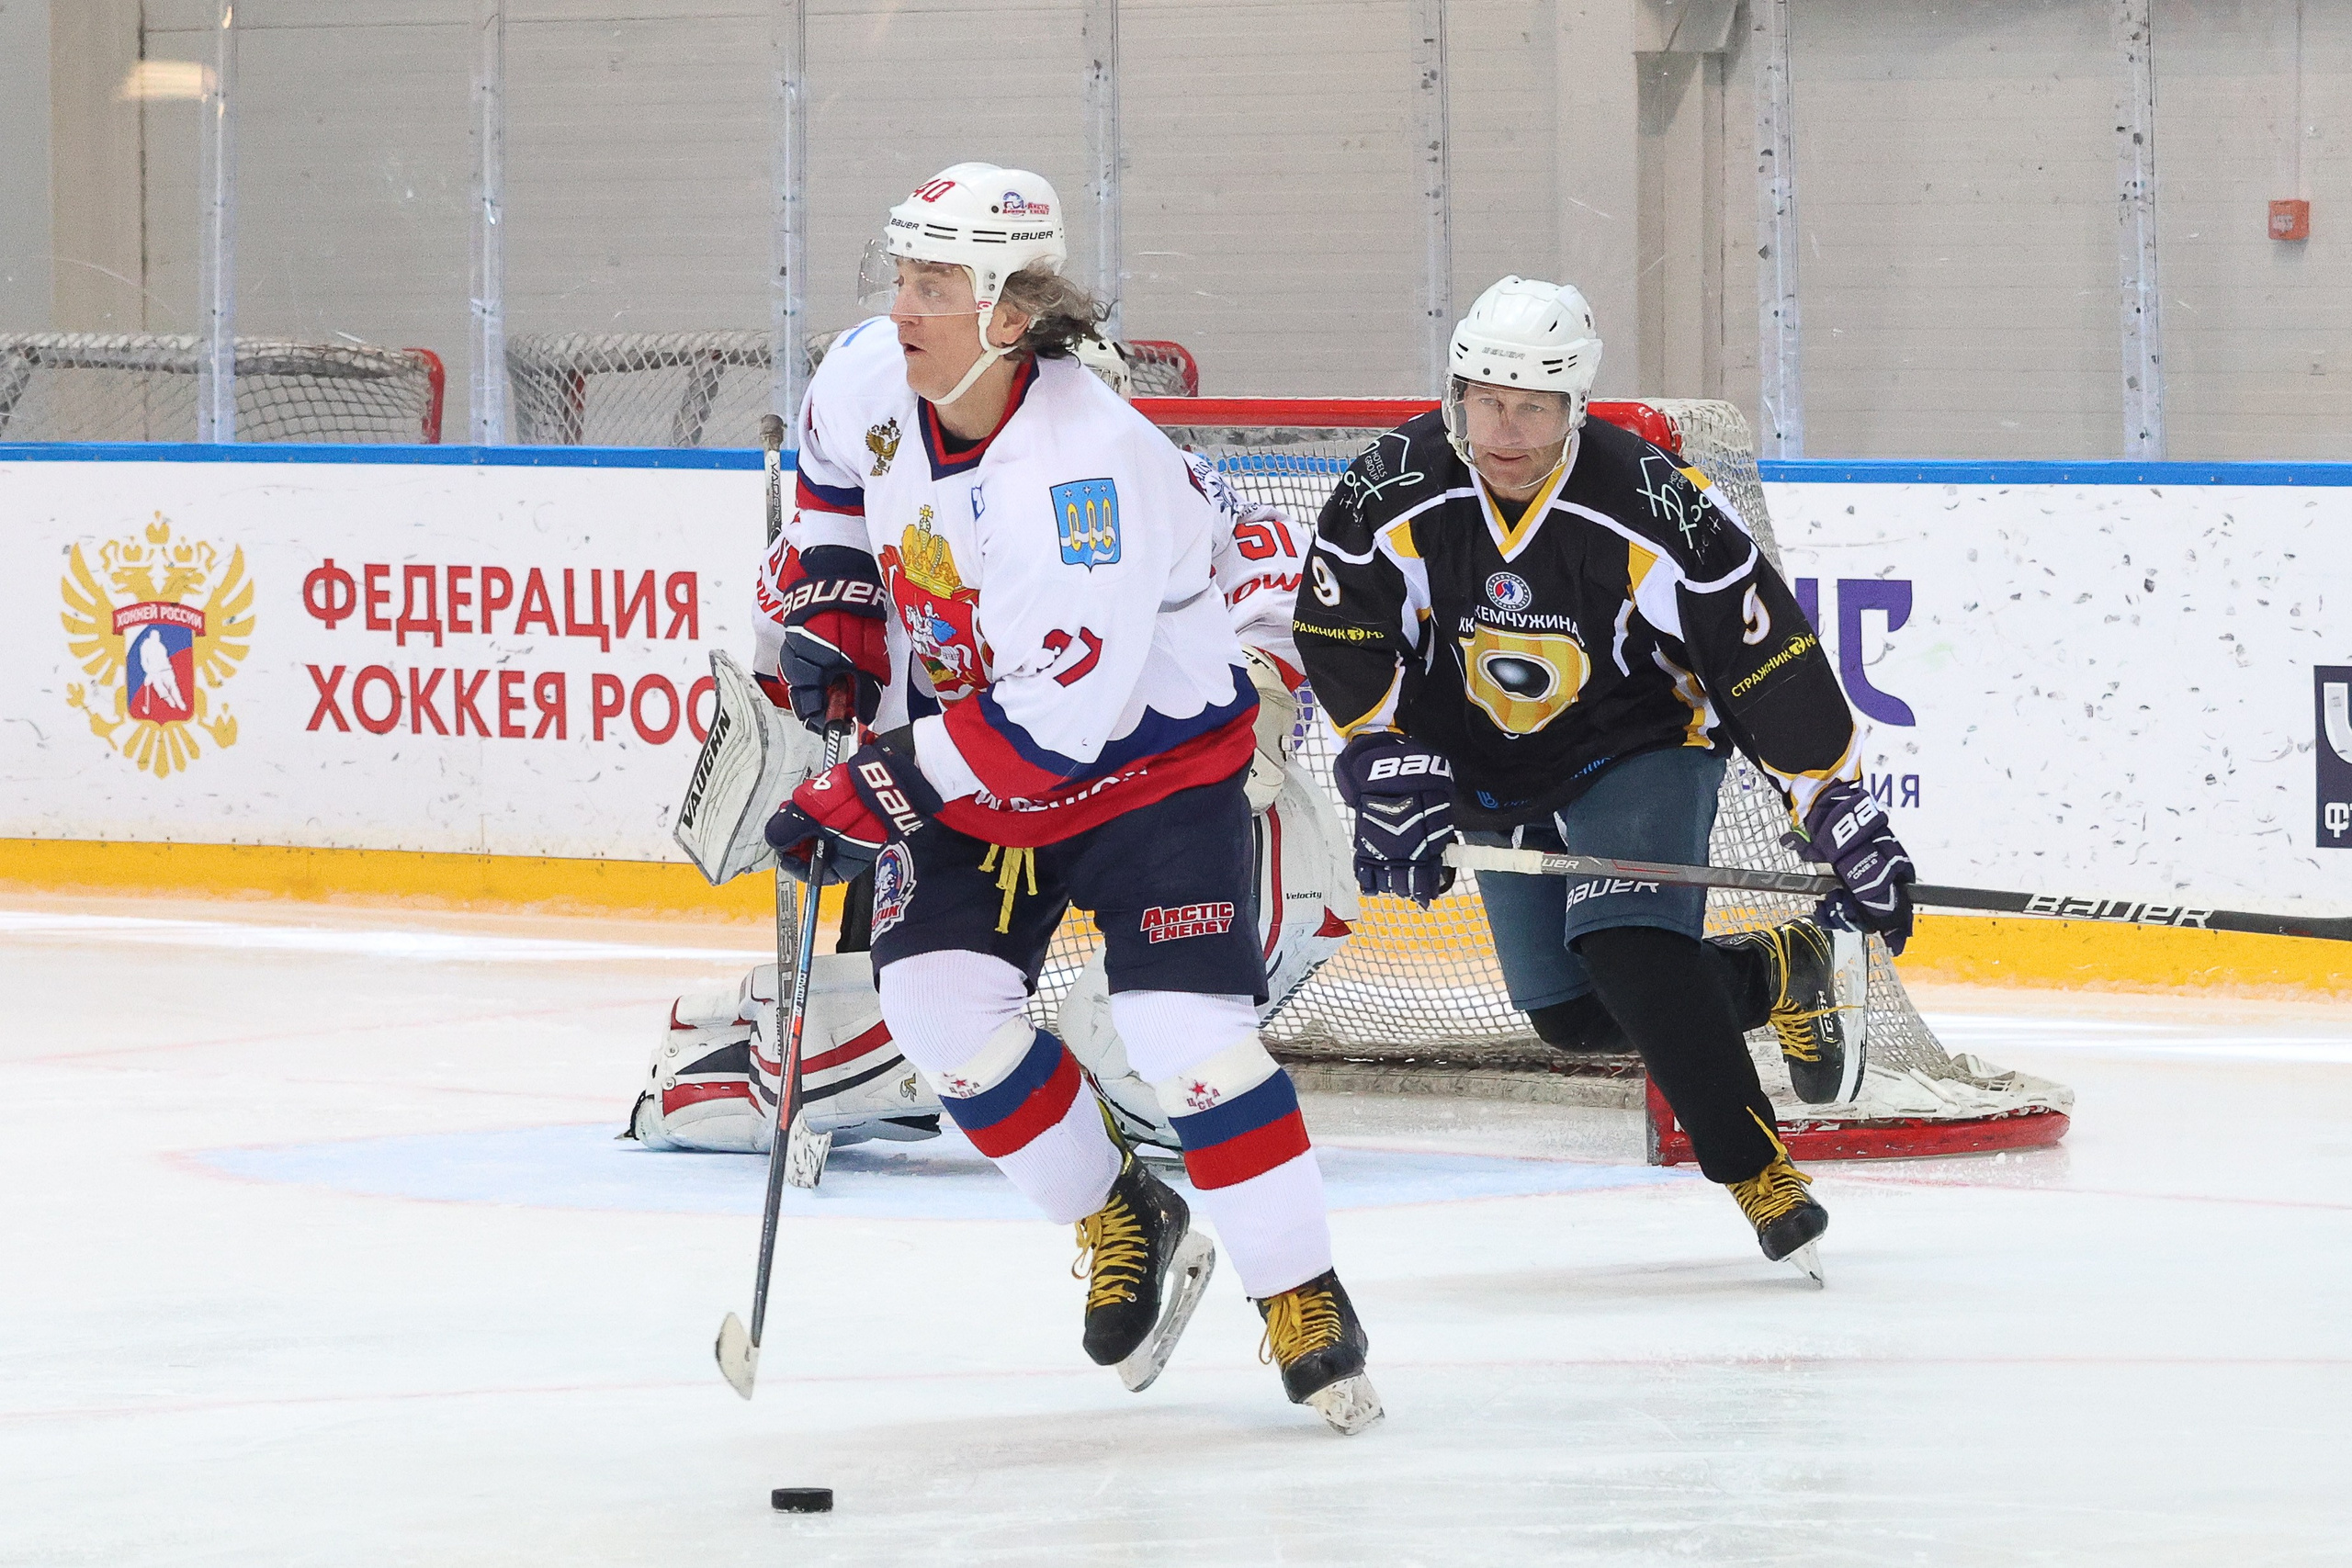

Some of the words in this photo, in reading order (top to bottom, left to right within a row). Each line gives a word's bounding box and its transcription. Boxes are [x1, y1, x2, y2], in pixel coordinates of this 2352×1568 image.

[913, 178, 956, 203] 40
[1364, 455, 1380, 481] GROUP
[1372, 450, 1387, 478] HOTELS
[1233, 519, 1298, 560] 51
[1311, 555, 1340, 606] 9
[116, 604, 158, 627] ХОККЕЙ
[160, 605, 203, 629] РОССИИ
[302, 558, 699, 651] ФЕДЕРАЦИЯ
[1293, 619, 1347, 640] РАЖНИК
[1731, 649, 1792, 697] СТРАЖНИК
[306, 664, 566, 740] ХОККЕЯ
[593, 672, 716, 745] РОС
[683, 706, 731, 829] VAUGHN
[1367, 754, 1454, 782] BAU
[858, 761, 923, 837] BAU
[1543, 858, 1579, 870] UER
[1285, 890, 1322, 900] Velocity
[1141, 902, 1234, 931] ARCTIC
[1149, 919, 1232, 943] ENERGY
[1186, 1089, 1221, 1110] ЦСКА
